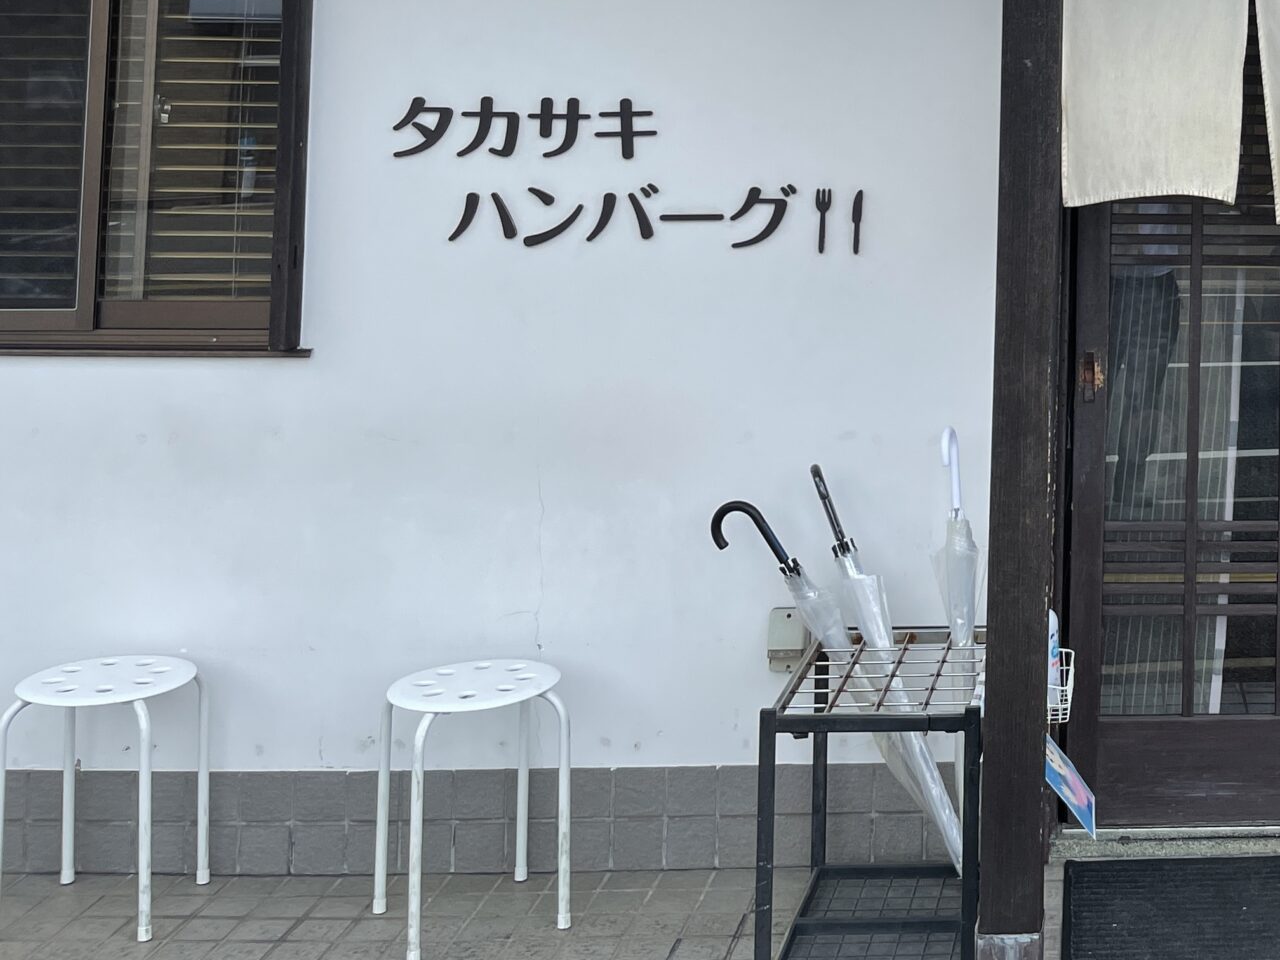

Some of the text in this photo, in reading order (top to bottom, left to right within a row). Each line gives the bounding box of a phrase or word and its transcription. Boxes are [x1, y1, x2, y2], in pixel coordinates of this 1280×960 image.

[392, 96, 658, 159] タカサキ
[447, 183, 798, 248] ハンバーグ
